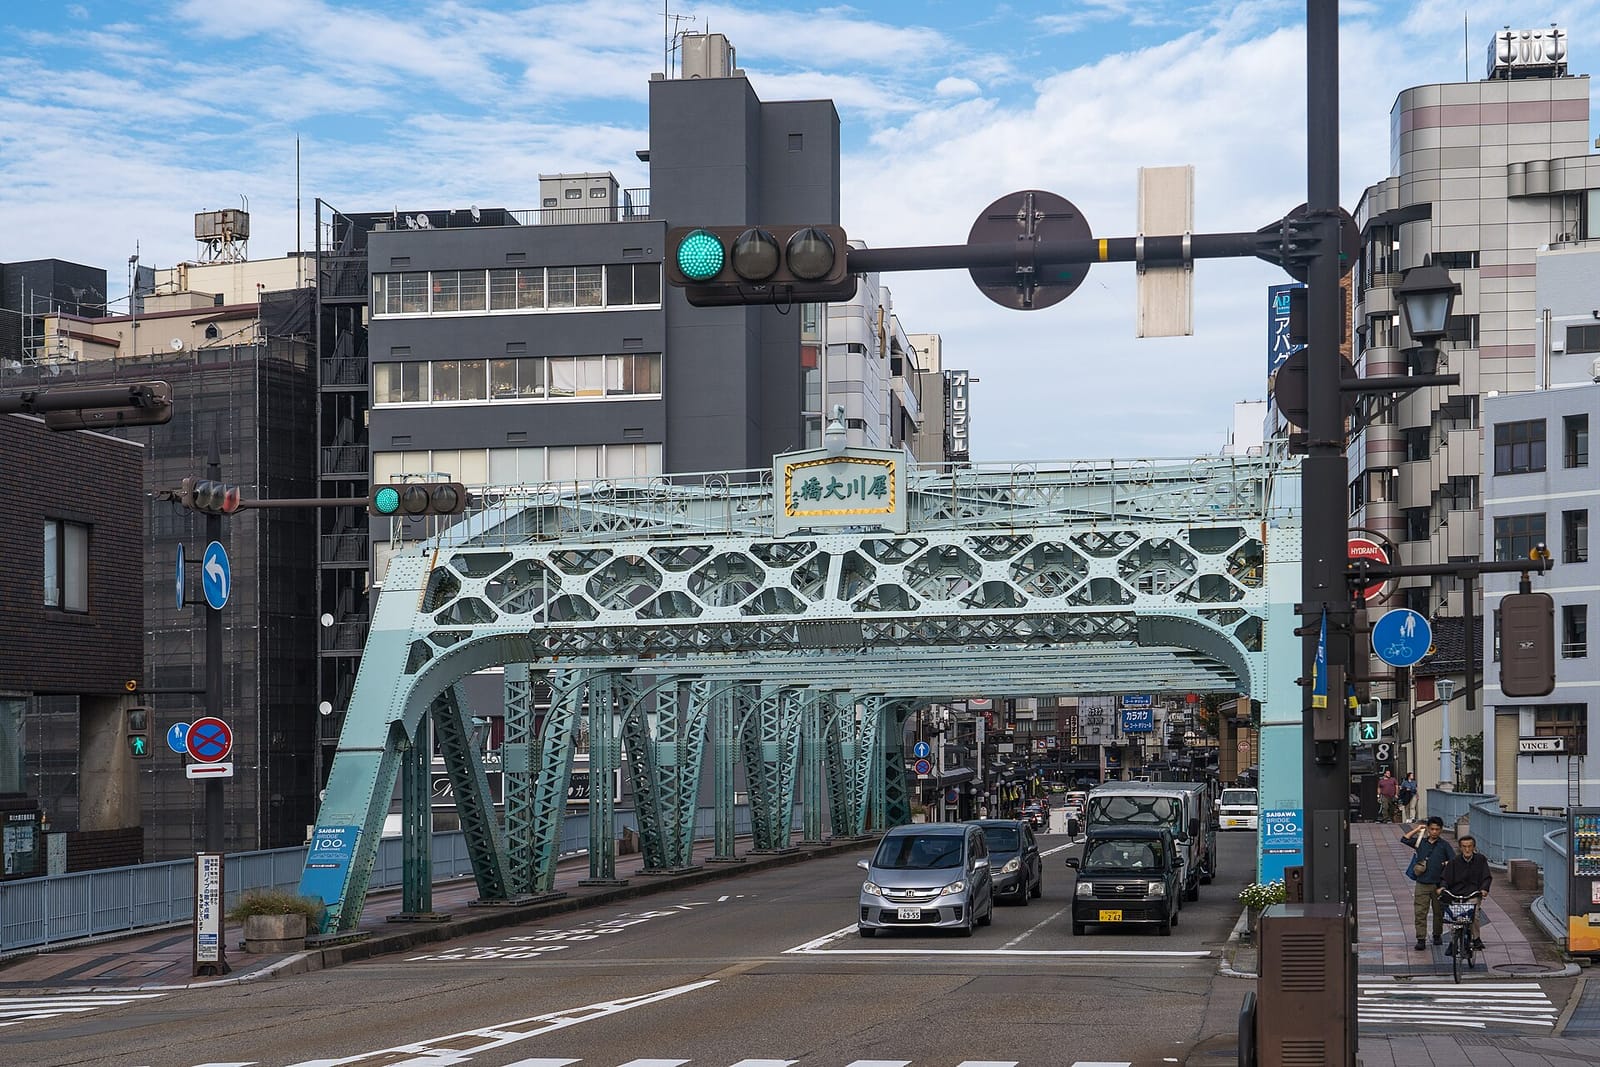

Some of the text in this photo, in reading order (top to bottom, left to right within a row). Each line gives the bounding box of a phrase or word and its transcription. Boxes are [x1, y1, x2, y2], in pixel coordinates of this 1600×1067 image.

[953, 373, 967, 453] オーロラビル
[1350, 546, 1379, 556] HYDRANT
[1521, 742, 1549, 750] VINCE
